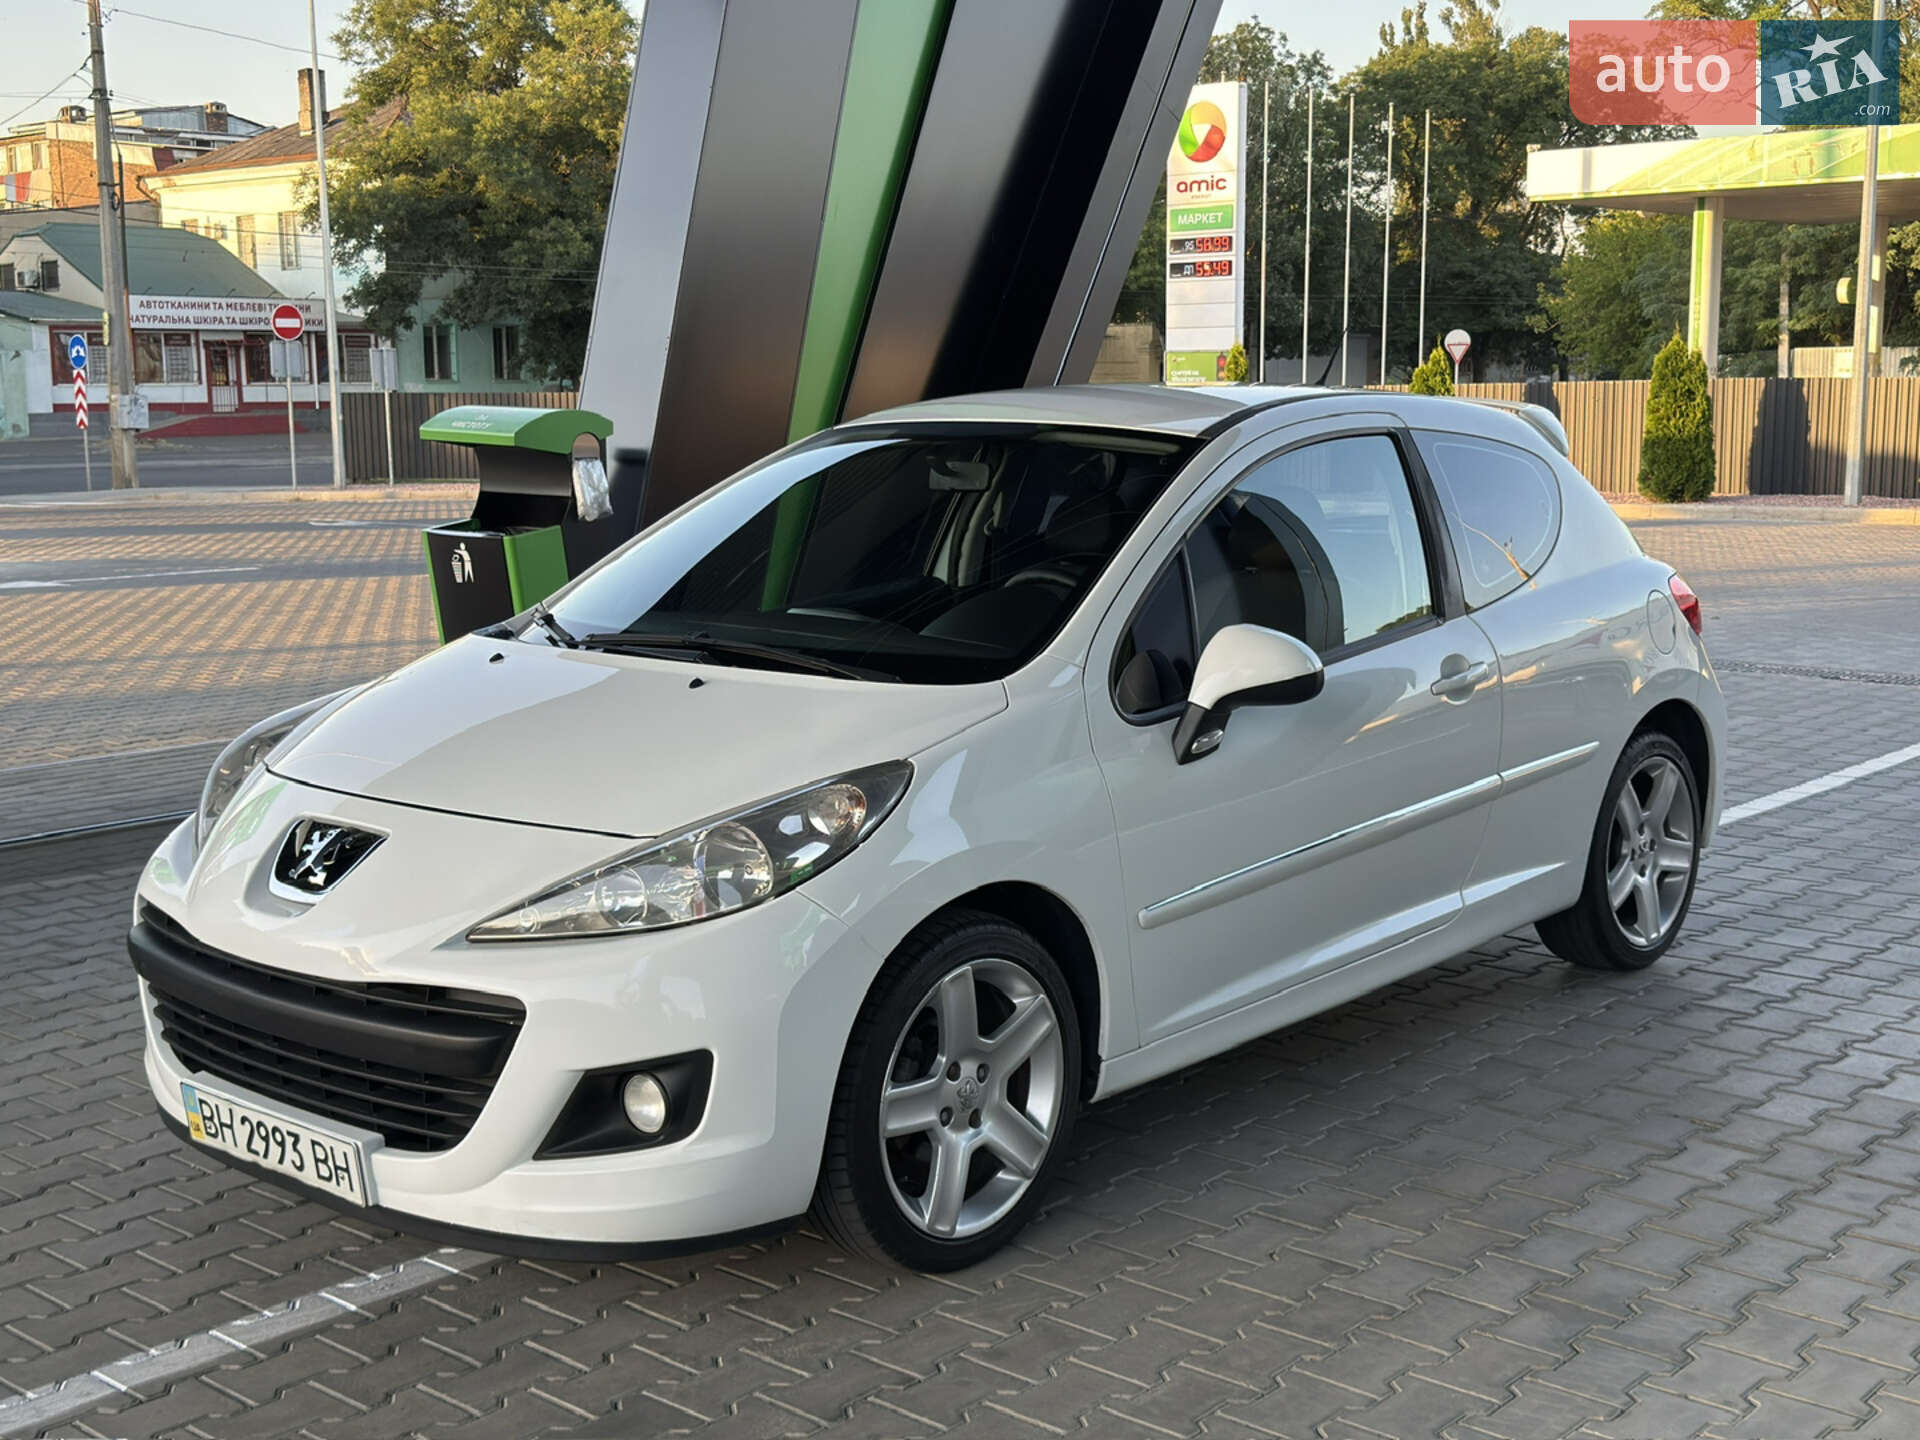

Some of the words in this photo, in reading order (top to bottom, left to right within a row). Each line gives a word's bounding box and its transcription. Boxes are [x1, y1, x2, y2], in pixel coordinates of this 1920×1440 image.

[1176, 174, 1228, 193] amic
[1177, 212, 1224, 225] МАРКЕТ
[138, 300, 211, 311] АВТОТКАНИНИ
[212, 302, 224, 311] ТА
[225, 302, 267, 313] МЕБЛЕВІ
[192, 315, 225, 326] ШКІРА
[225, 316, 238, 326] ТА
[198, 1097, 239, 1148] BH
[240, 1114, 305, 1172] 2993
[310, 1138, 354, 1193] BH
